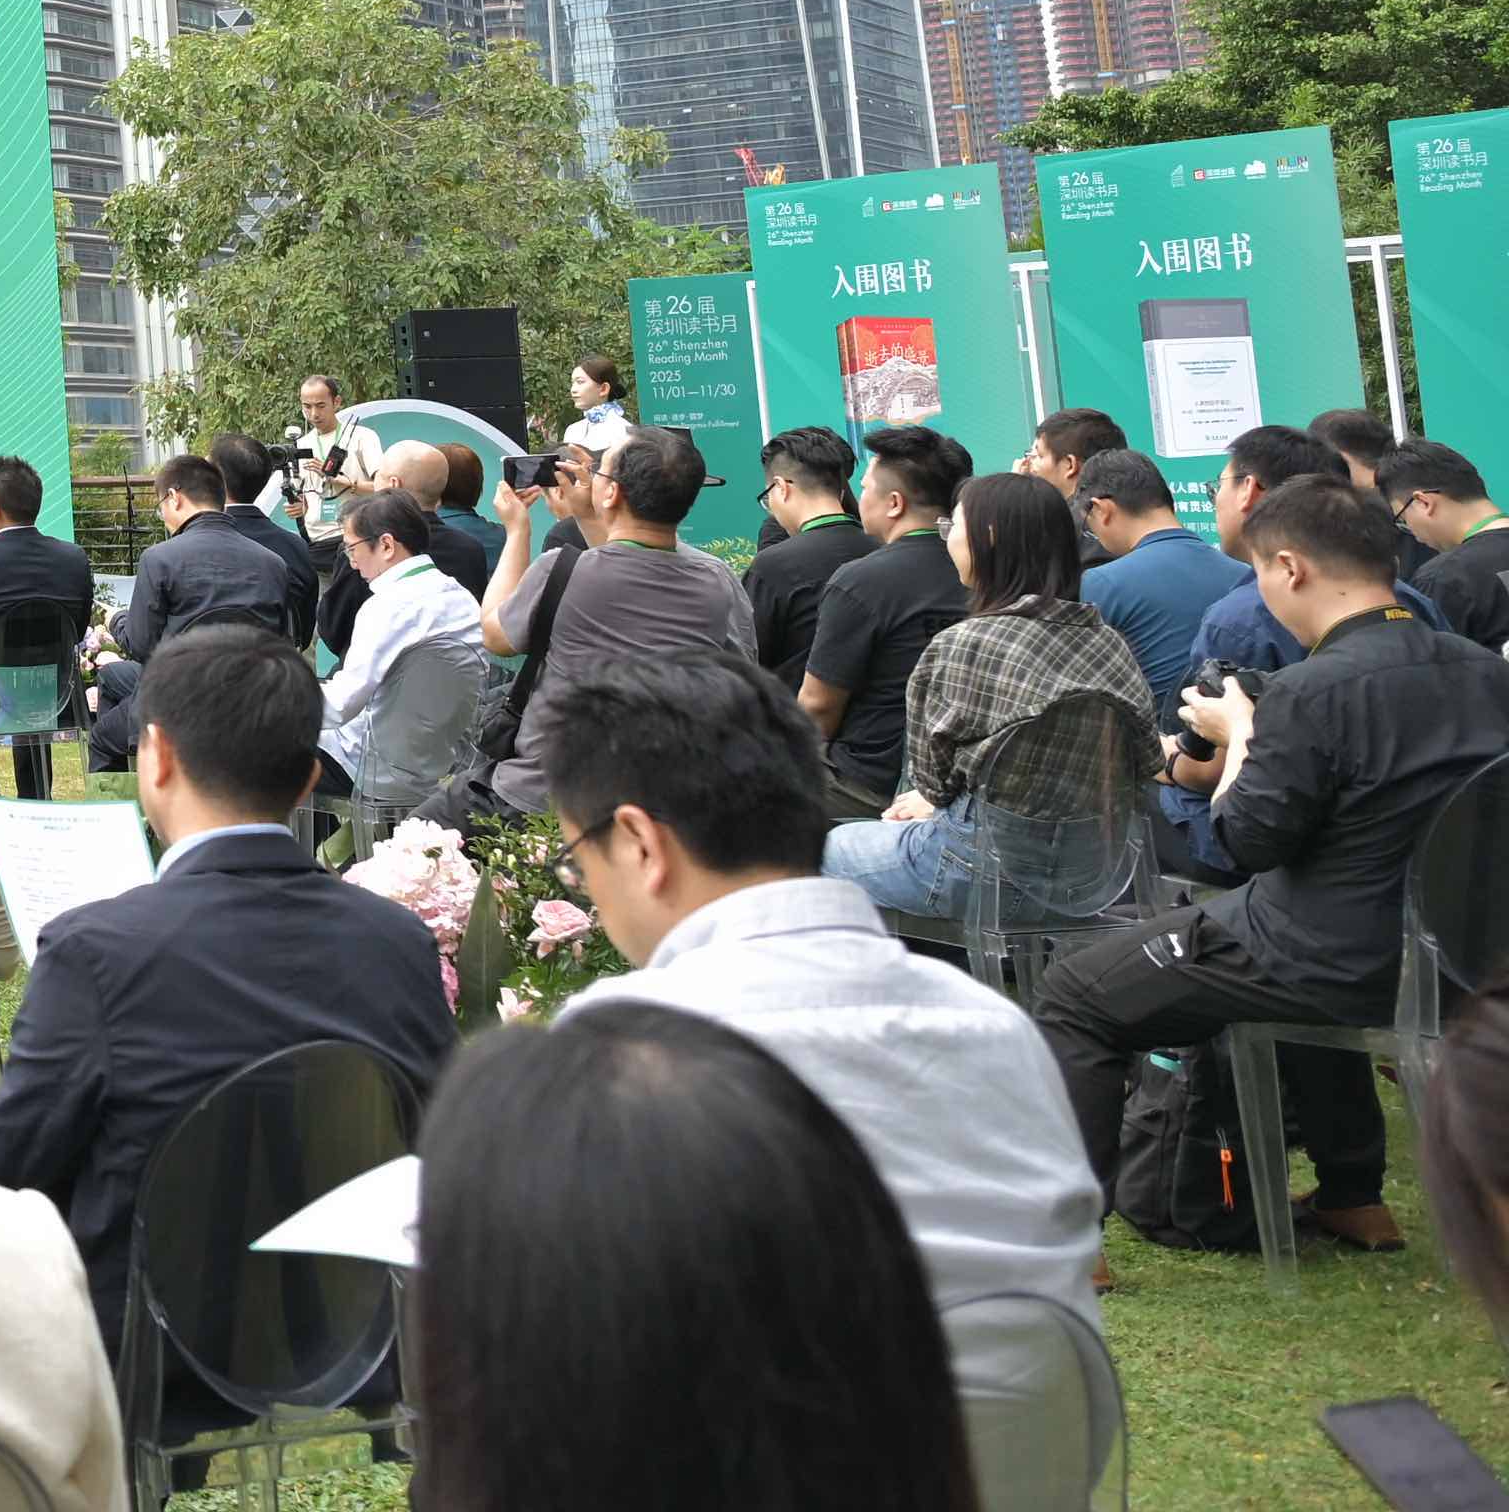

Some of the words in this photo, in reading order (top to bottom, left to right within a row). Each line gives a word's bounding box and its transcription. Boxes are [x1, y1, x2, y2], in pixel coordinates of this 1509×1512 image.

[1418, 151, 1489, 170] 深圳读书月
[1135, 232, 1253, 278] 入围图书
[832, 258, 933, 299] 入围图书
[646, 315, 738, 337] 深圳读书月
[674, 339, 728, 351] Shenzhen
[648, 353, 692, 365] Reading
[694, 351, 728, 362] Month
[650, 370, 681, 383] 2025
